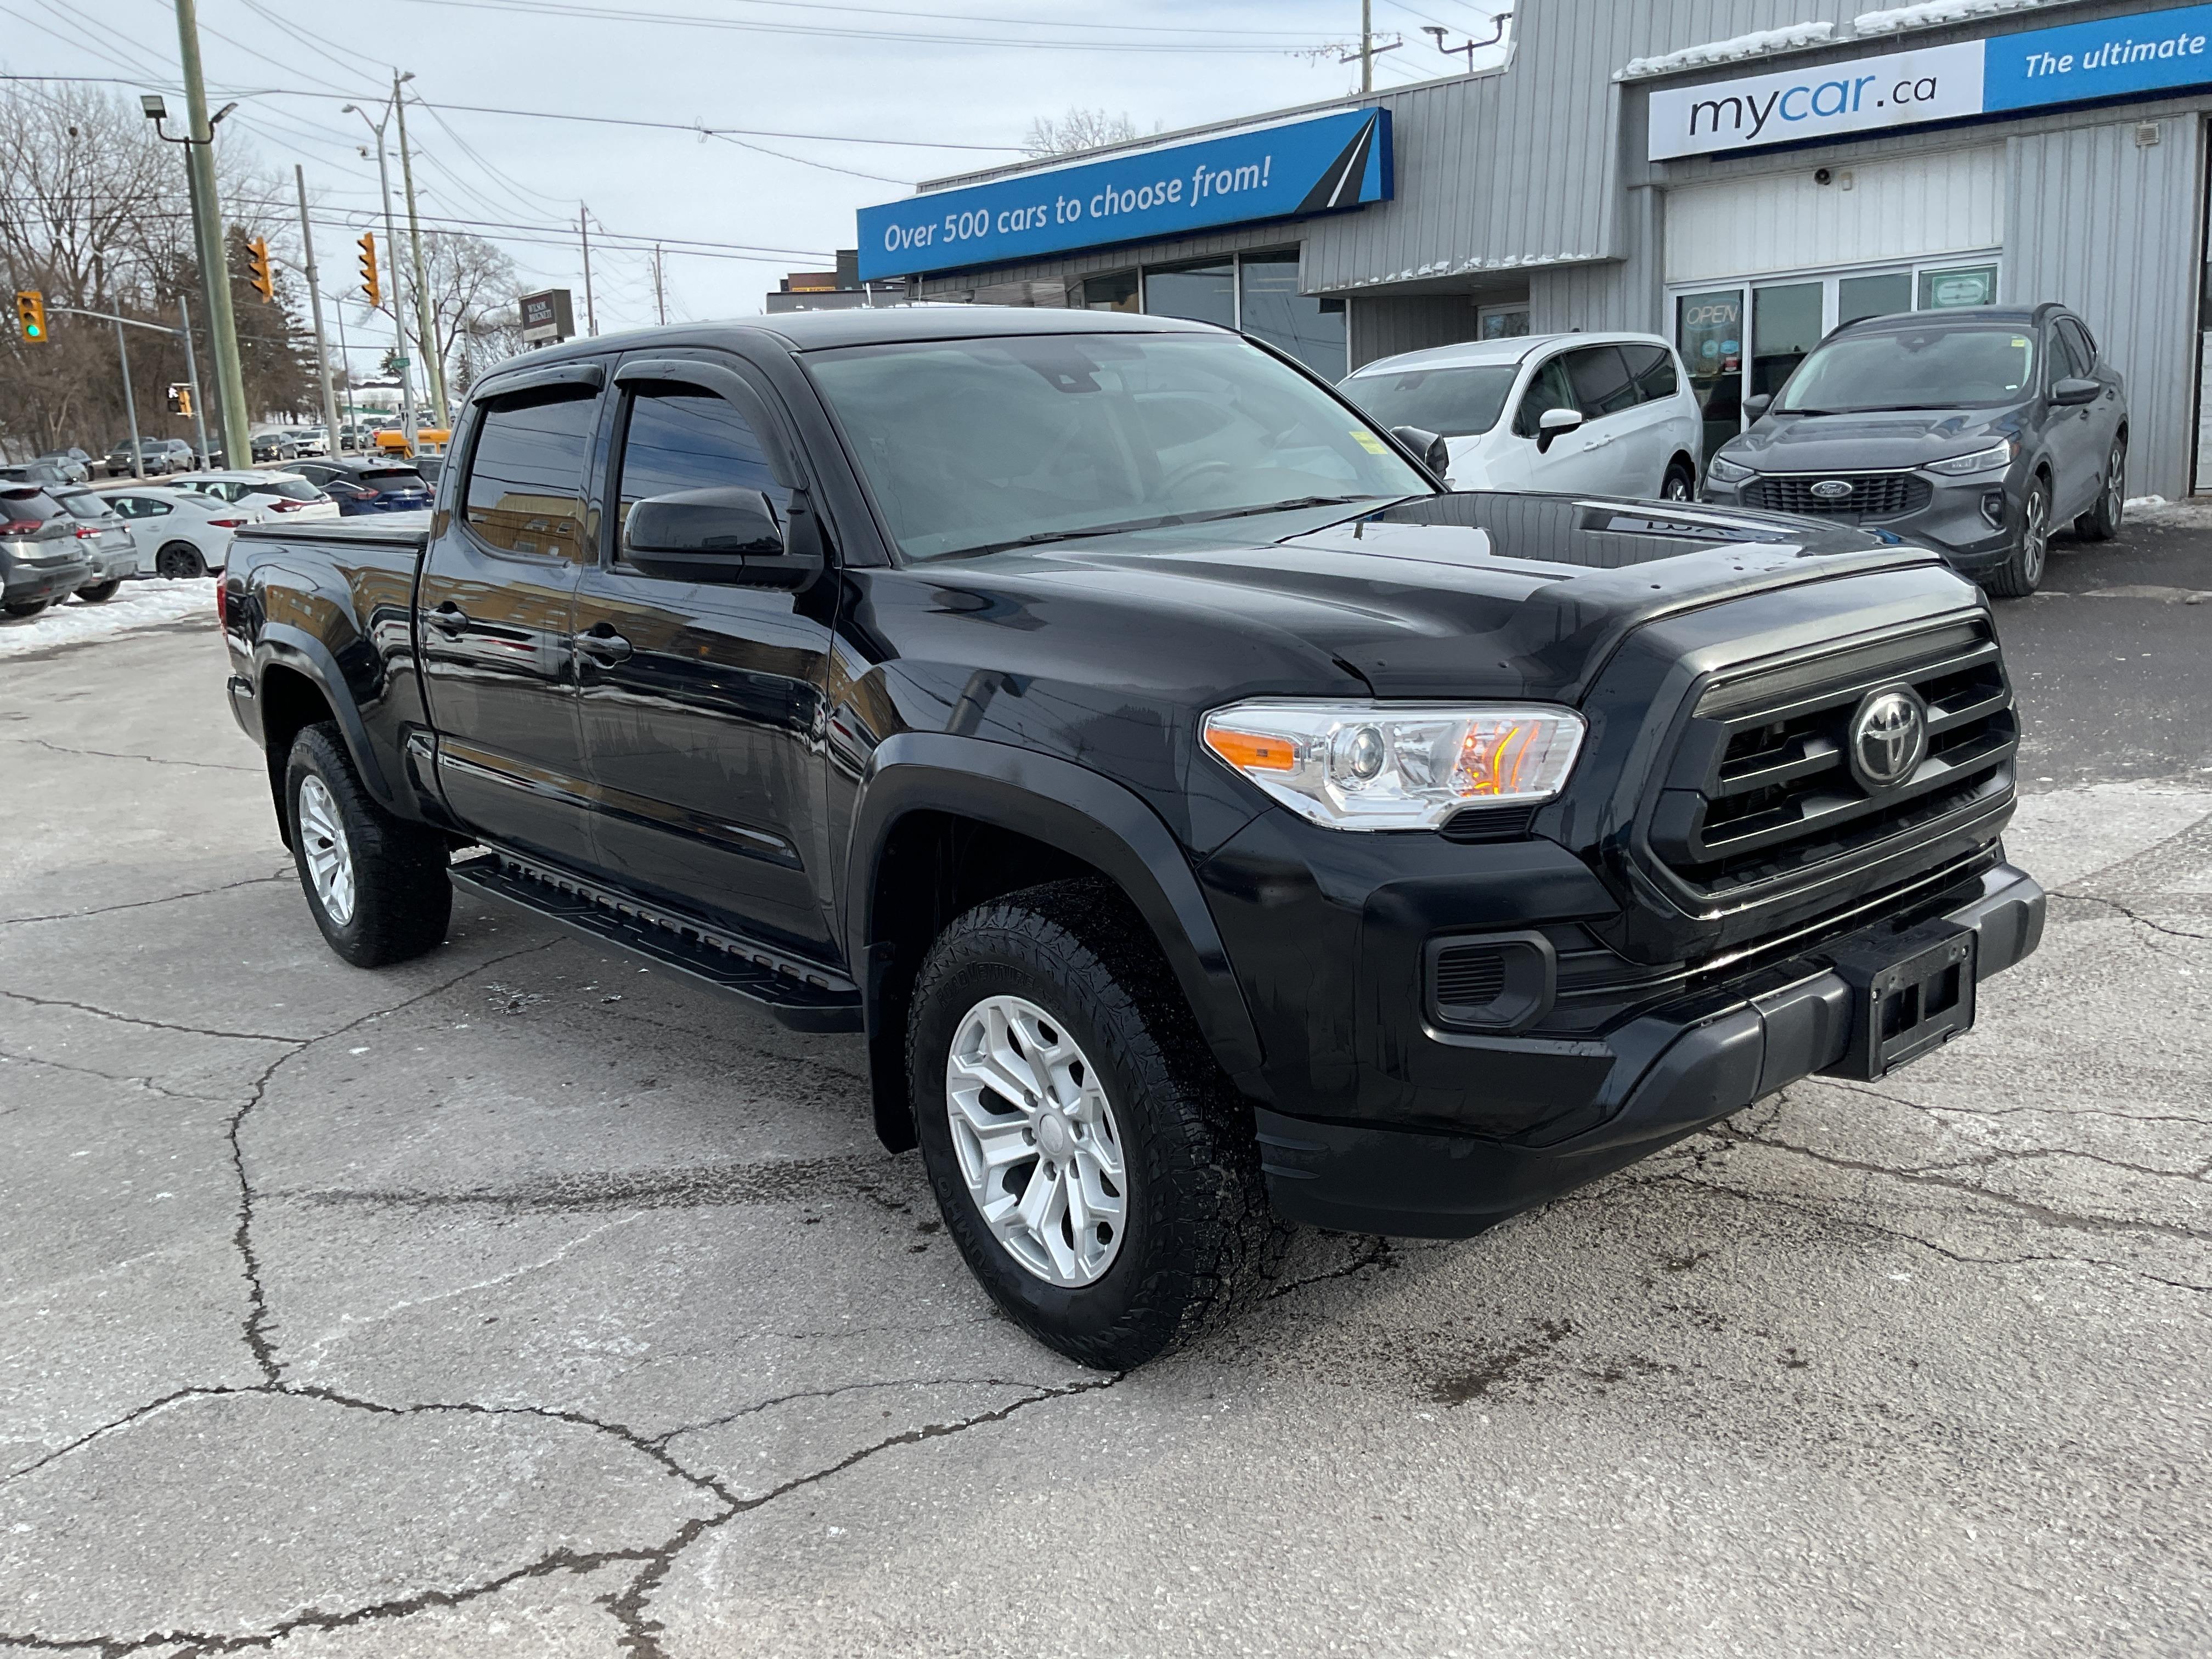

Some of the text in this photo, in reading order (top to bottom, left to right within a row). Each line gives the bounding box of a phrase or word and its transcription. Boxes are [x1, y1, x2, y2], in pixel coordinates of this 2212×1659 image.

[2025, 33, 2206, 77] The ultimate
[1689, 75, 1937, 140] mycar.ca
[884, 155, 1271, 251] Over 500 cars to choose from!
[1686, 304, 1739, 325] OPEN
[1820, 484, 1843, 494] Ford
